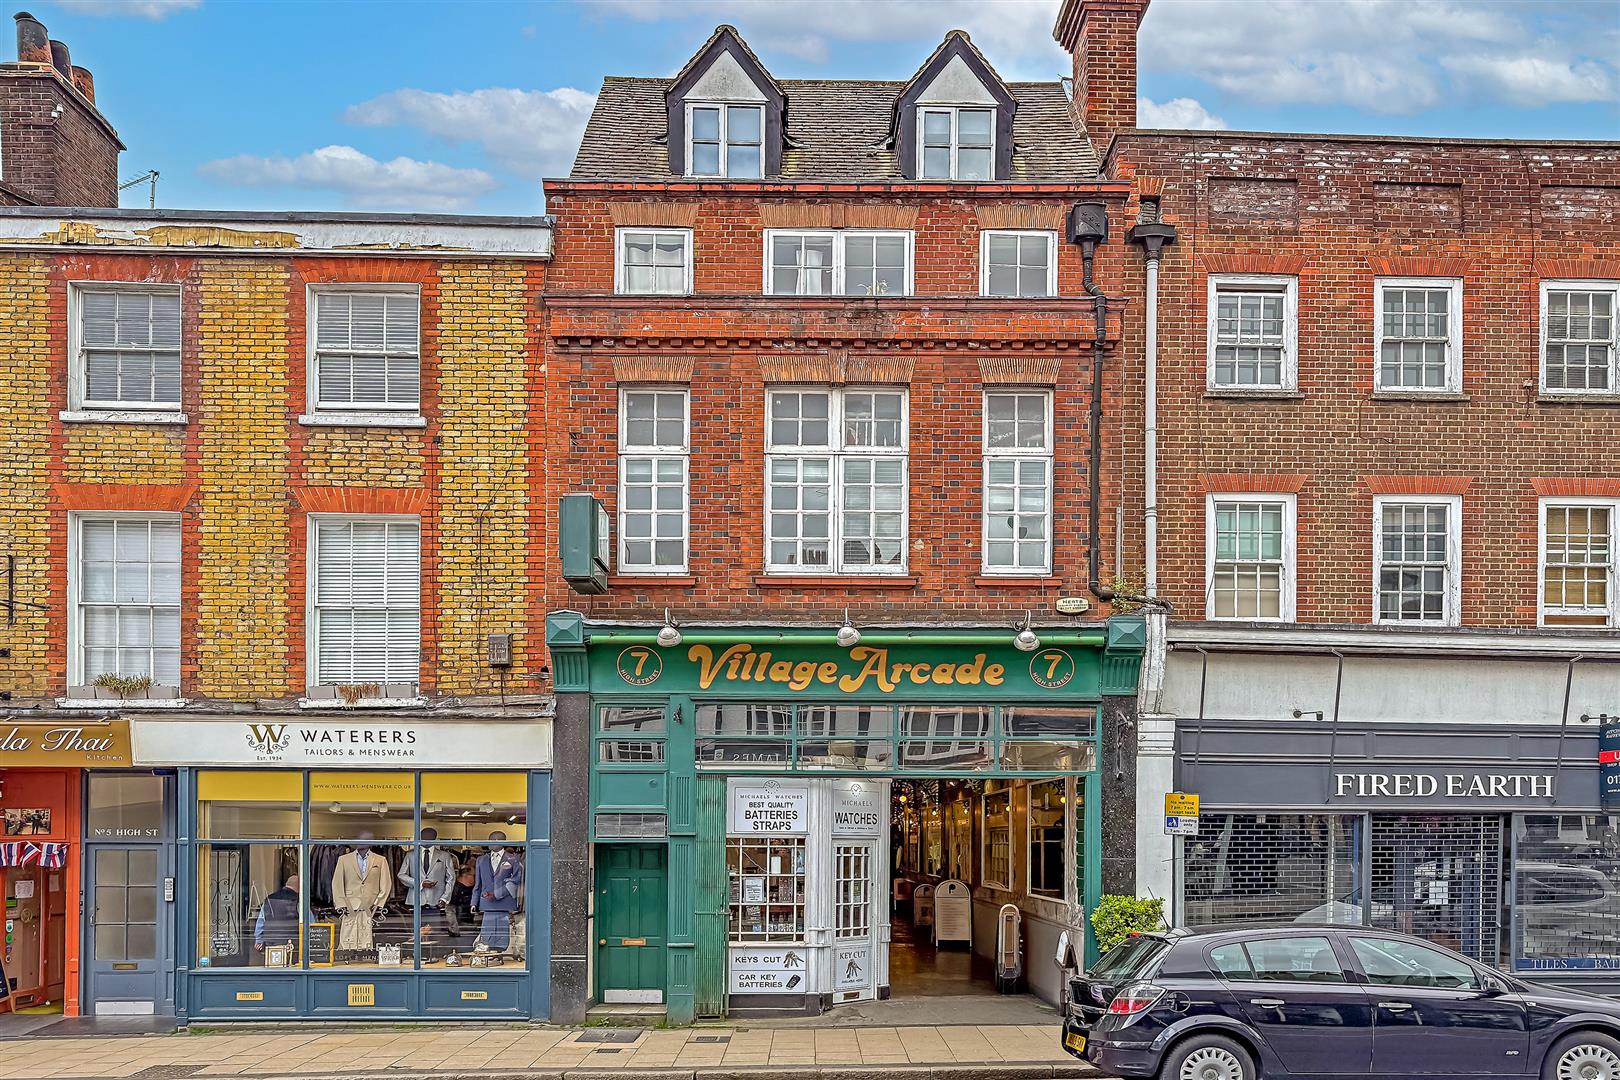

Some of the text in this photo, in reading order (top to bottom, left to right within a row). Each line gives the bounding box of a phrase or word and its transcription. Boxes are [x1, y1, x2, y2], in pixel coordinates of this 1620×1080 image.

[630, 652, 649, 676] 7
[688, 644, 1006, 693] Village Arcade
[1044, 654, 1062, 679] 7
[620, 669, 659, 684] HIGH STREET
[1032, 672, 1070, 686] HIGH STREET
[41, 727, 114, 751] Thai
[300, 730, 416, 744] WATERERS
[1335, 774, 1554, 798] FIRED EARTH
[744, 810, 798, 820] BATTERIES
[834, 812, 878, 824] WATCHES
[752, 821, 792, 830] STRAPS
[840, 950, 866, 960] KEY CUT
[1532, 960, 1620, 968] TILES BAT
